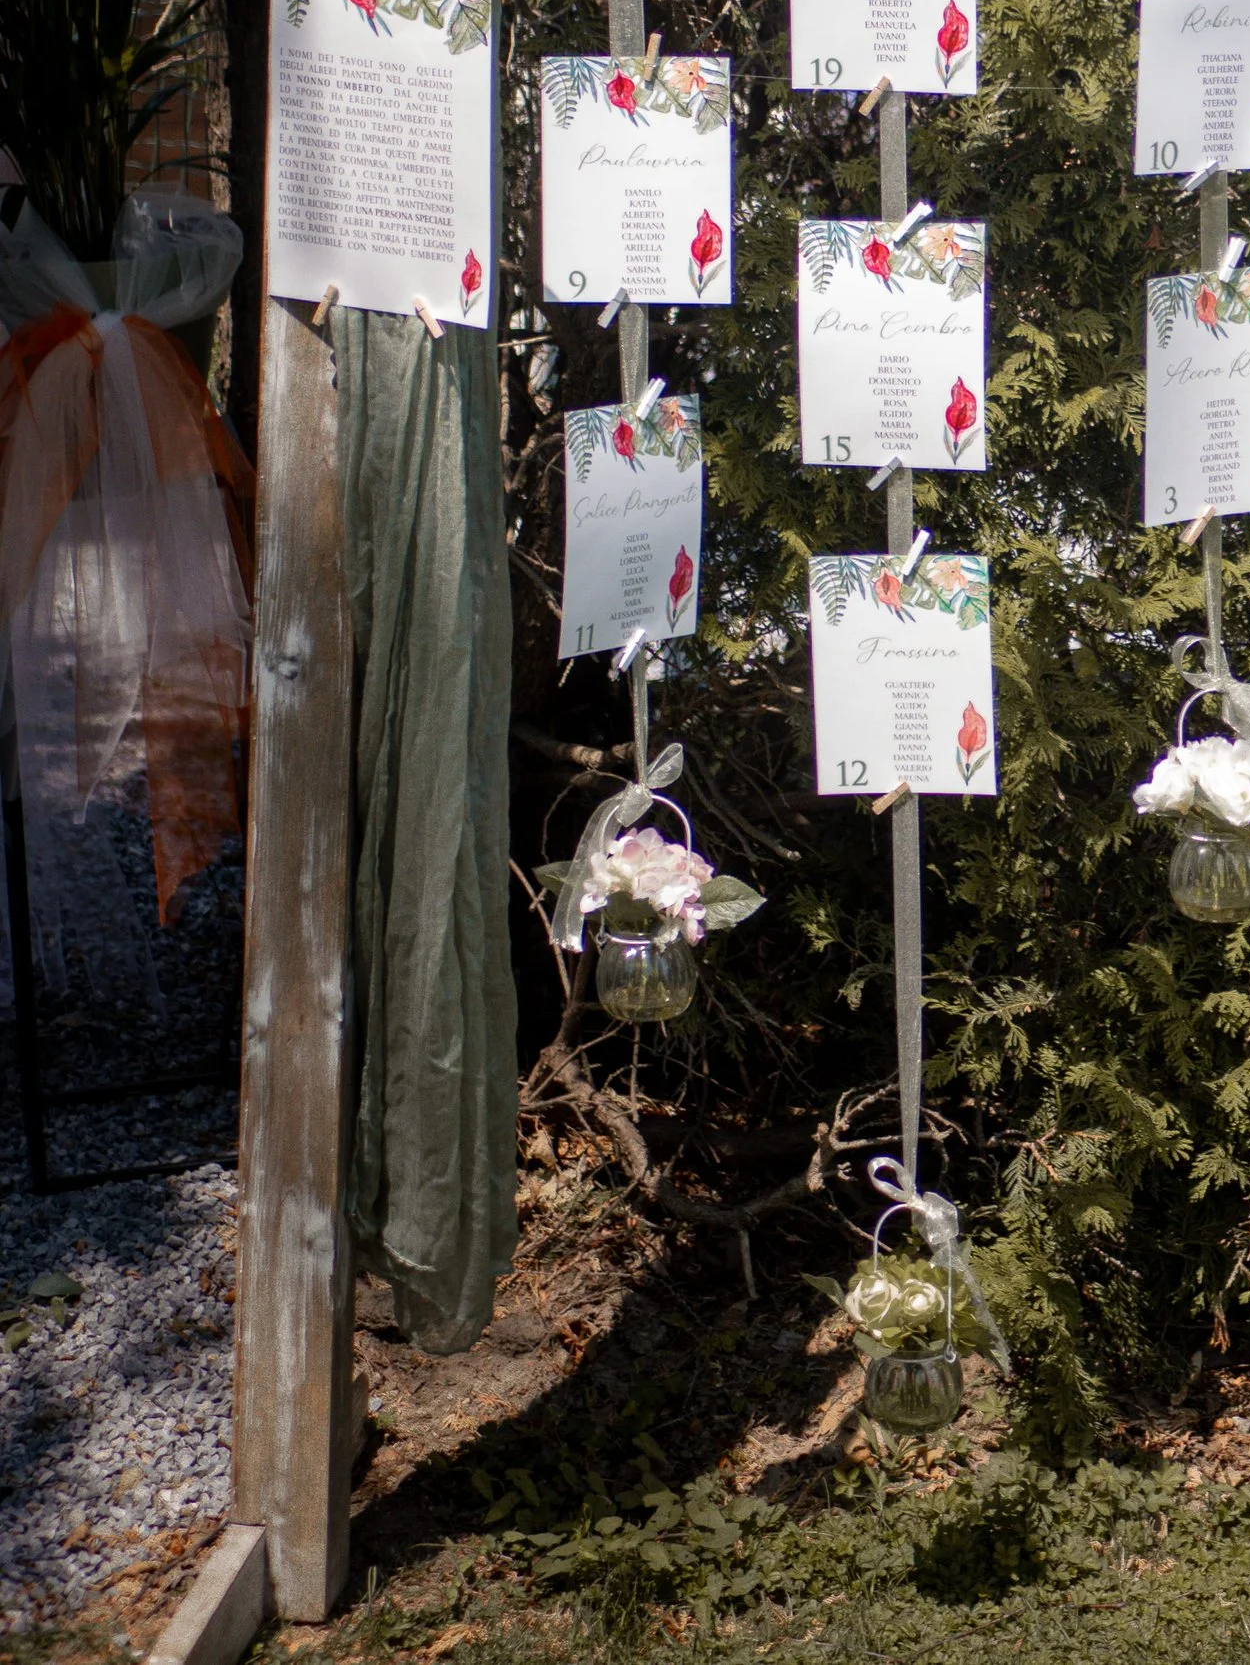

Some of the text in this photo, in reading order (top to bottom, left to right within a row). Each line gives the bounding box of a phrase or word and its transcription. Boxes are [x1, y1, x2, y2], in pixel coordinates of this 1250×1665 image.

[872, 10, 909, 20] FRANCO
[865, 20, 916, 30] EMANUELA
[288, 48, 312, 61] NOMI
[318, 53, 333, 63] DEI
[340, 56, 373, 69] TAVOLI
[378, 61, 405, 73] SONO
[416, 66, 452, 79] QUELLI
[1201, 54, 1242, 64] THACIANA
[810, 58, 842, 86] 19
[1197, 65, 1244, 74] GUILHERME
[280, 72, 412, 98] DA NONNO UMBERTO DAL
[1202, 98, 1237, 107] STEFANO
[1205, 110, 1233, 119] NICOLE
[578, 142, 707, 170] Paulownia
[1150, 141, 1178, 170] 10
[625, 189, 662, 197] DANILO
[622, 211, 664, 219] ALBERTO
[622, 233, 665, 241] CLAUDIO
[279, 230, 343, 247] INDISSOLUBILE
[348, 241, 366, 251] CON
[371, 244, 405, 256] NONNO
[569, 271, 587, 298] 9
[813, 307, 975, 339] Pino Cembro
[1163, 357, 1224, 387] Acero
[869, 377, 921, 385] DOMENICO
[873, 388, 917, 396] GIUSEPPE
[1207, 399, 1236, 410] HEITOR
[879, 410, 912, 418] EGIDIO
[1207, 420, 1235, 431] PIETRO
[821, 435, 851, 462] 15
[1201, 461, 1240, 474] ENGLAND
[1209, 473, 1233, 483] BRYAN
[573, 481, 698, 528] Salice Piangente
[1165, 486, 1177, 515] 3
[626, 565, 645, 576] LUCA
[609, 605, 654, 622] ALESSANDRO
[576, 623, 596, 654] 11
[856, 637, 959, 664] Frassino
[885, 681, 935, 689] GUALTIERO
[893, 754, 932, 762] DANIELA
[837, 760, 868, 787] 12
